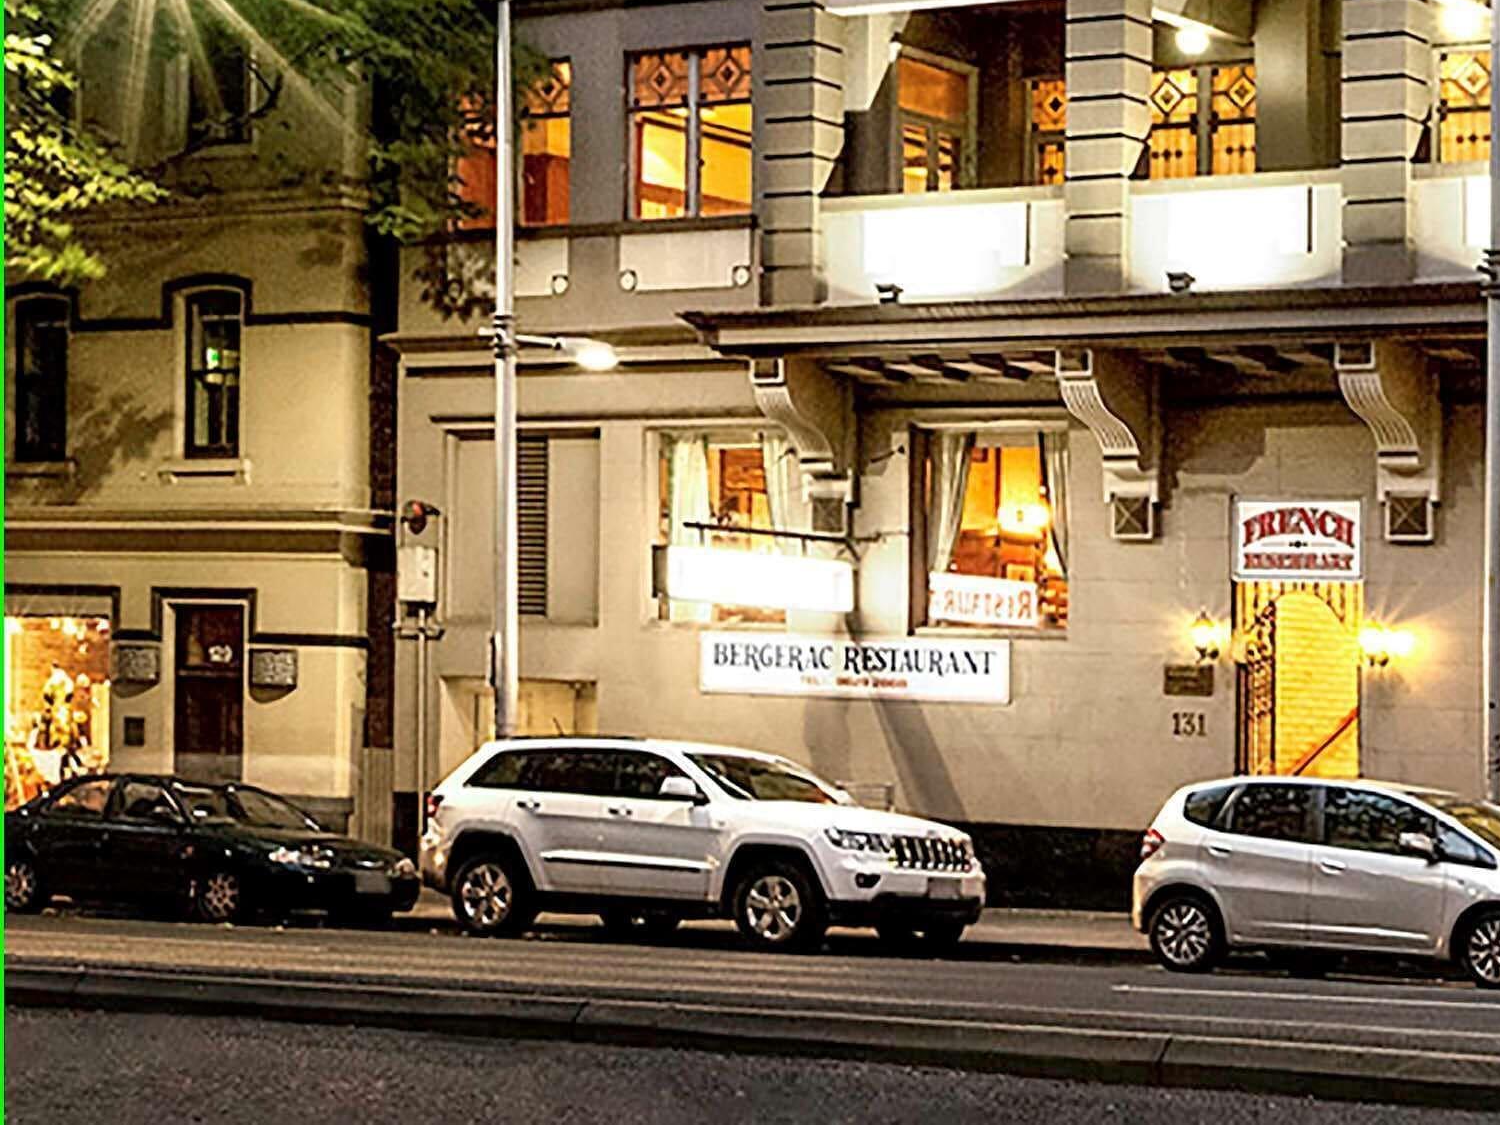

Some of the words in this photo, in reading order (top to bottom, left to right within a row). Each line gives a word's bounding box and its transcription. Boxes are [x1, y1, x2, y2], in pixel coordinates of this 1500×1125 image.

[1243, 507, 1355, 548] FRENCH
[713, 643, 833, 671] BERGERAC
[844, 646, 996, 676] RESTAURANT
[1172, 712, 1207, 736] 131
